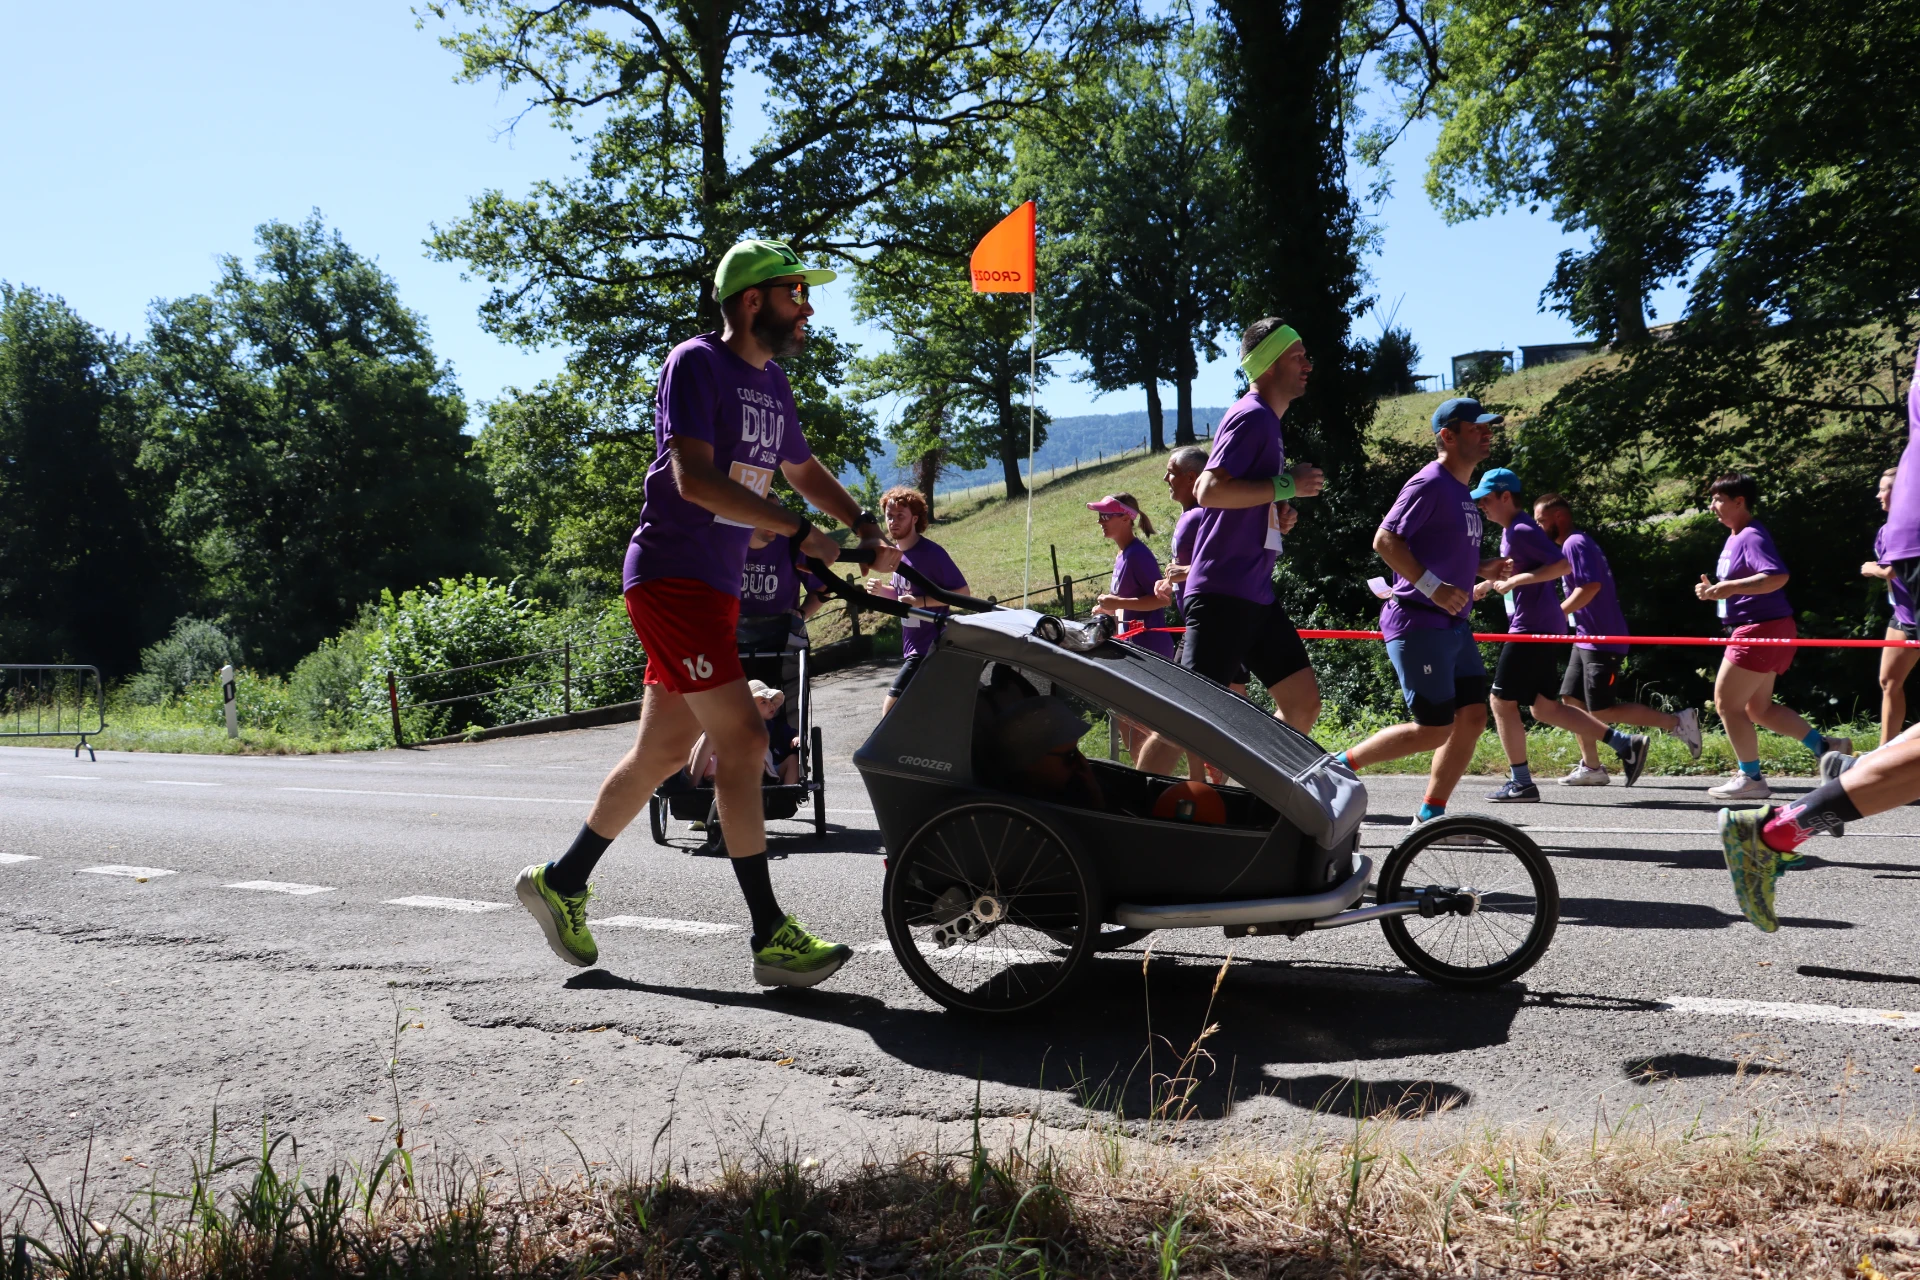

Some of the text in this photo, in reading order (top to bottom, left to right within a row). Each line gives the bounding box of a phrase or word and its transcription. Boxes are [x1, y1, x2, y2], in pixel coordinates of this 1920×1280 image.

[737, 387, 775, 408] COURSE
[741, 404, 785, 451] DUO
[740, 468, 768, 499] 134
[743, 563, 766, 573] URSE
[682, 653, 714, 681] 16
[898, 755, 953, 772] CROOZER
